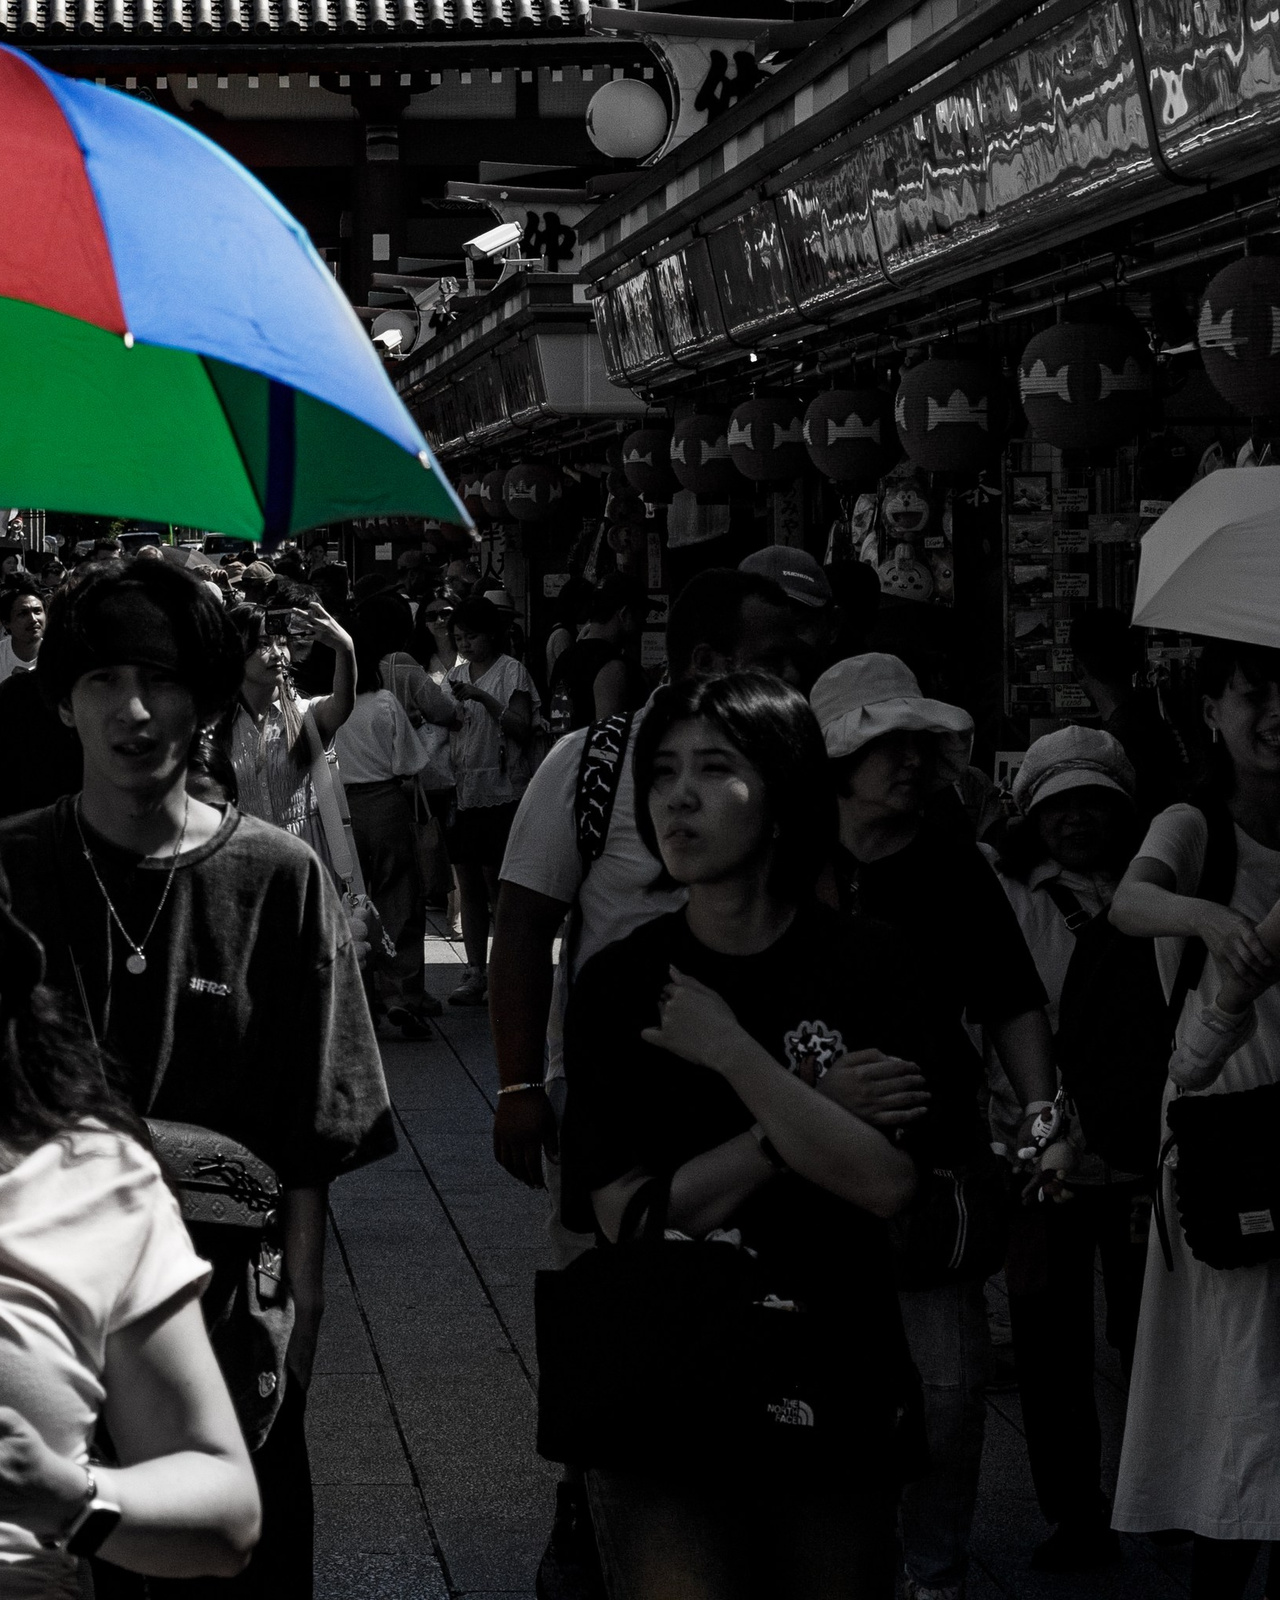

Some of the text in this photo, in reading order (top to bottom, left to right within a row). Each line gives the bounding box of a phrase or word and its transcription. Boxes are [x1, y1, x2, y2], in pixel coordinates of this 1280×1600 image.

[782, 1397, 799, 1408] THE
[767, 1403, 799, 1416] NORTH
[774, 1413, 798, 1425] FACE
